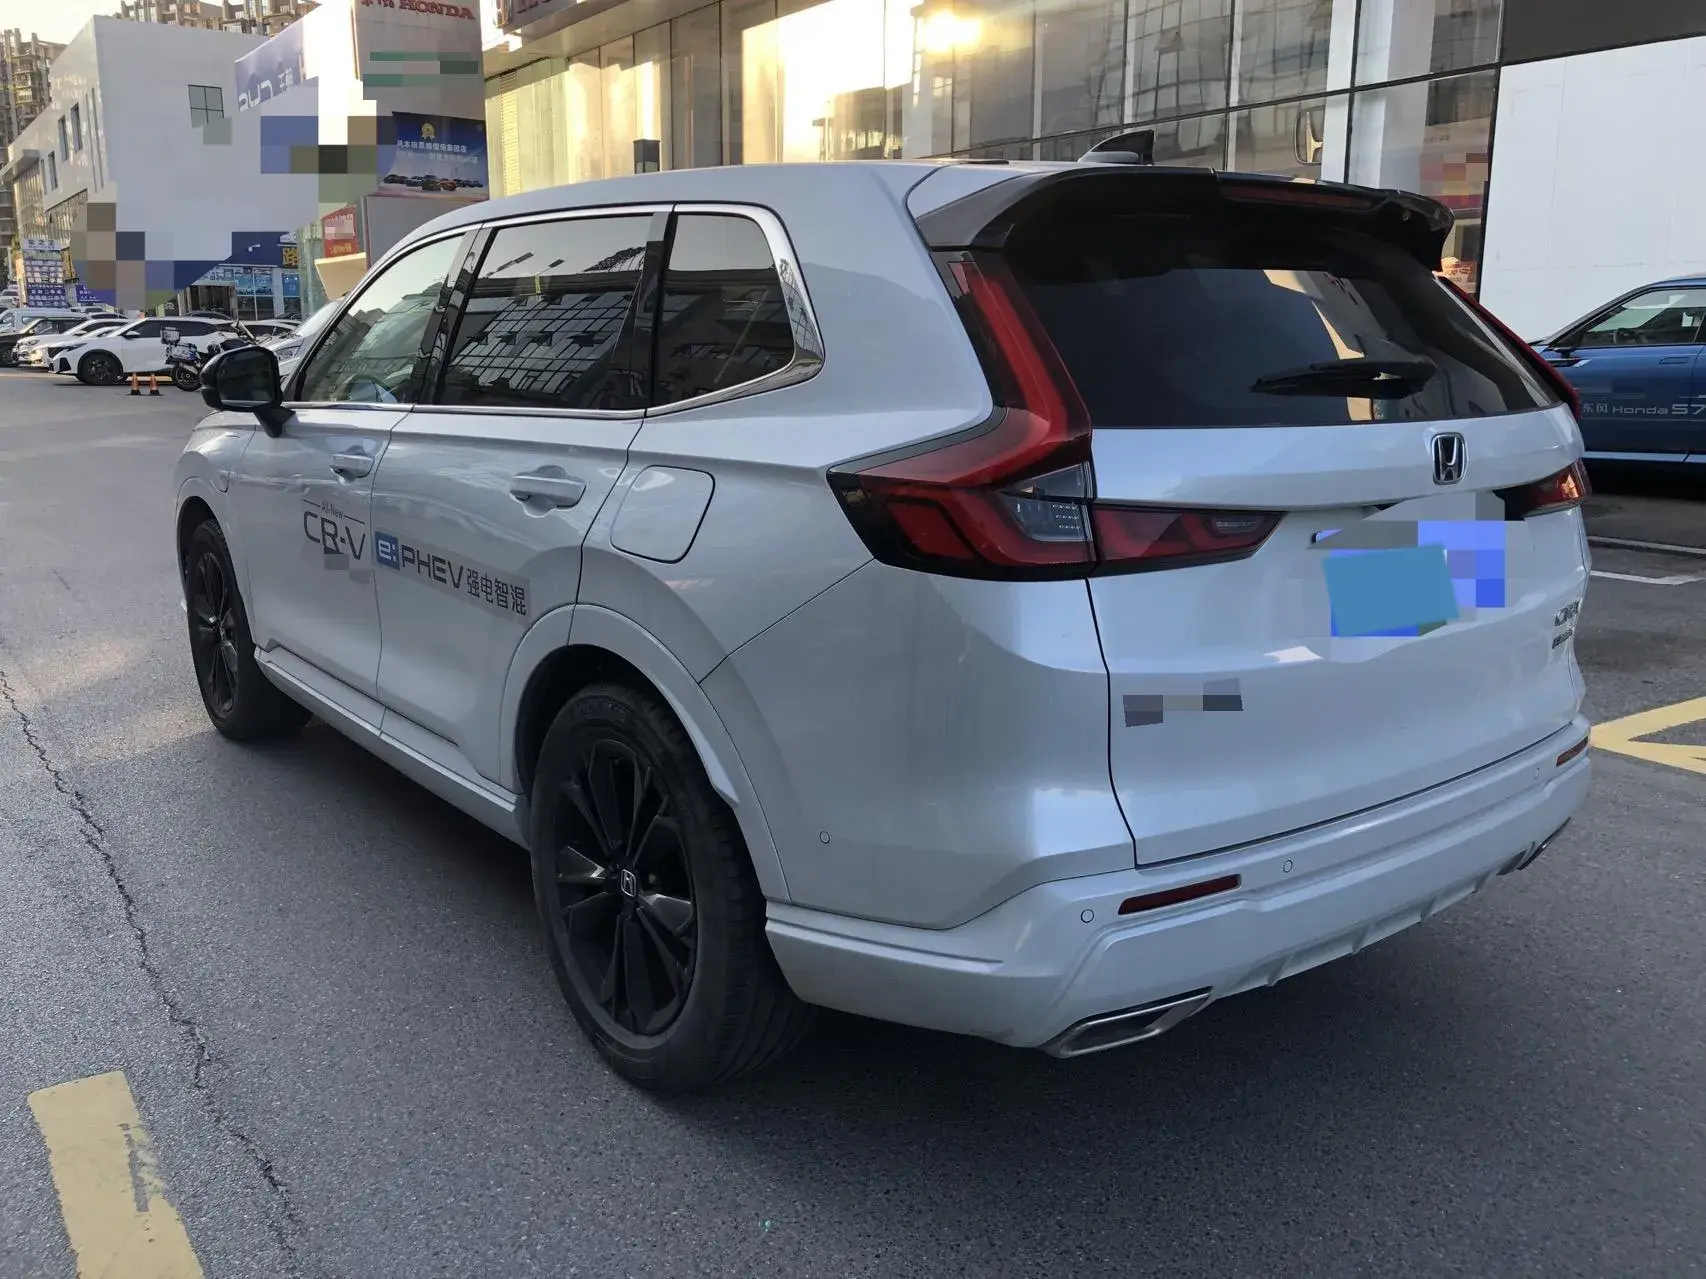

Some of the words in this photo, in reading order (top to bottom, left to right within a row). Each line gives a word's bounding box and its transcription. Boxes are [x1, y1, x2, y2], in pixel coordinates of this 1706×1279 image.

[399, 0, 475, 20] HONDA
[1612, 405, 1669, 415] Honda
[1671, 403, 1706, 415] S7
[303, 510, 366, 560] CR-V
[466, 568, 527, 616] 强电智混
